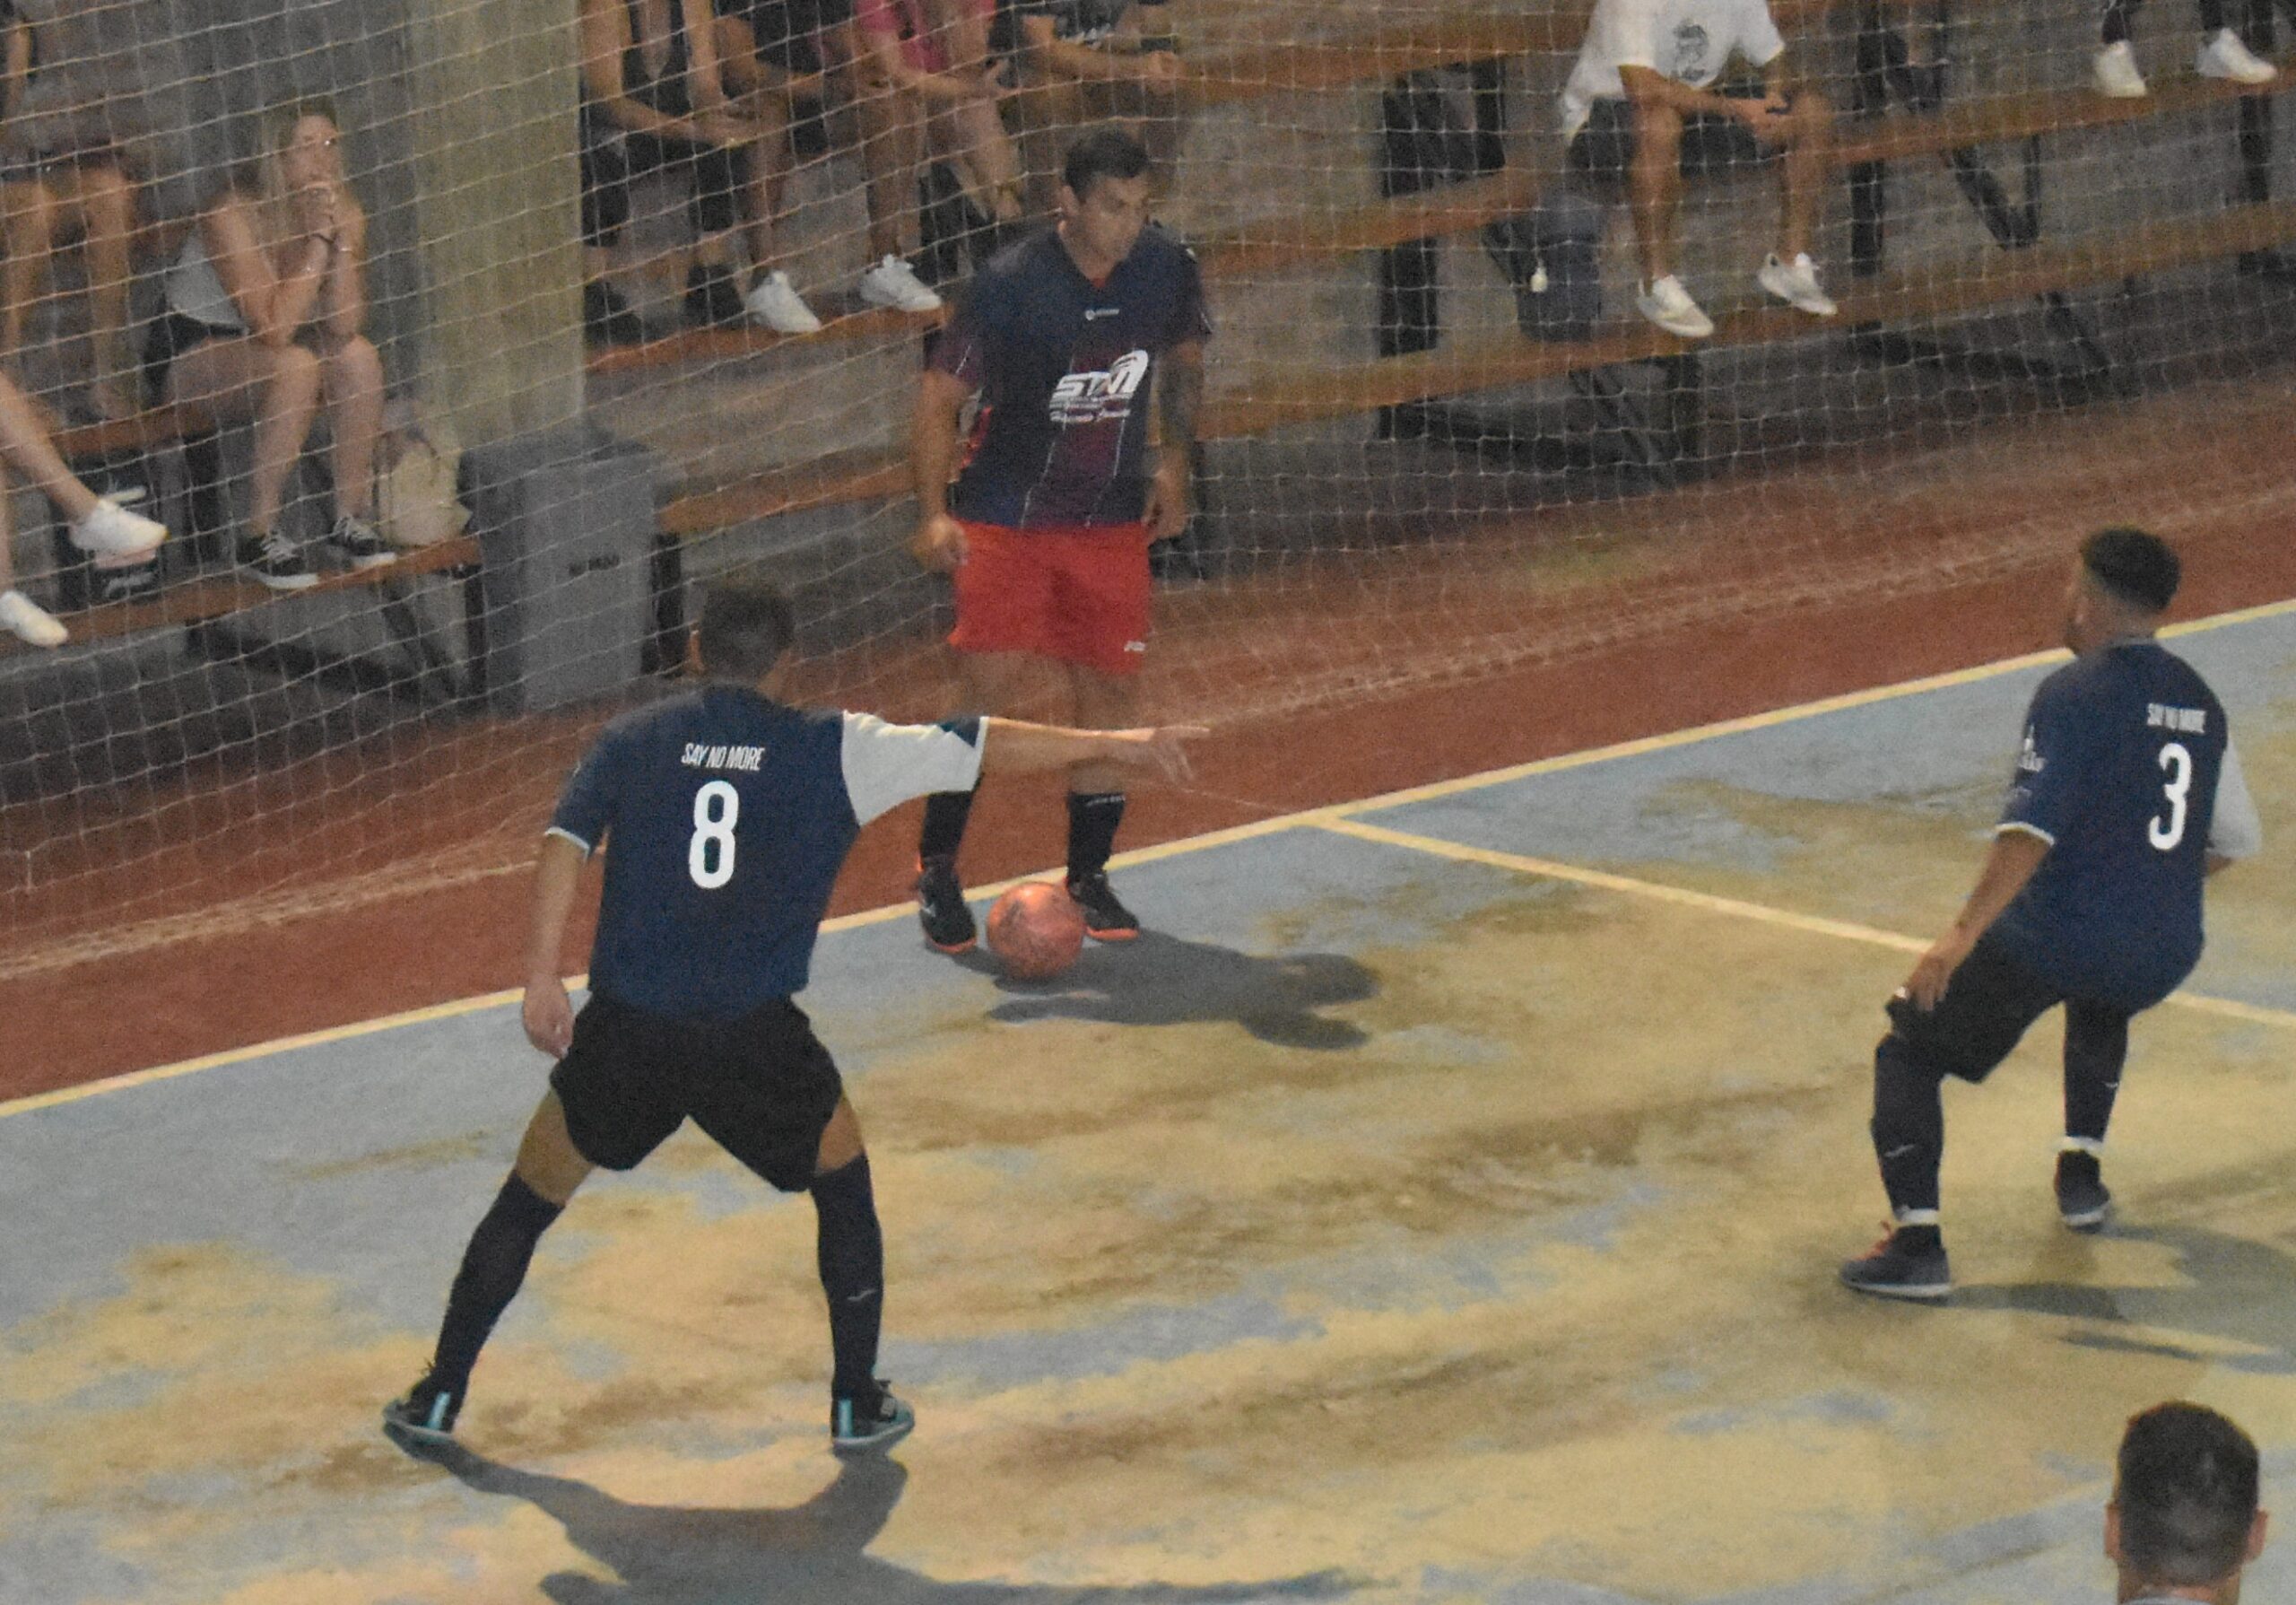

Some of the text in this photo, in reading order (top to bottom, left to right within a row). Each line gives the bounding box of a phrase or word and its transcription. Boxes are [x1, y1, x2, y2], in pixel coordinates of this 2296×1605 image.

[681, 743, 765, 772] SAY NO MORE
[2148, 743, 2191, 850] 3
[689, 781, 739, 889] 8
